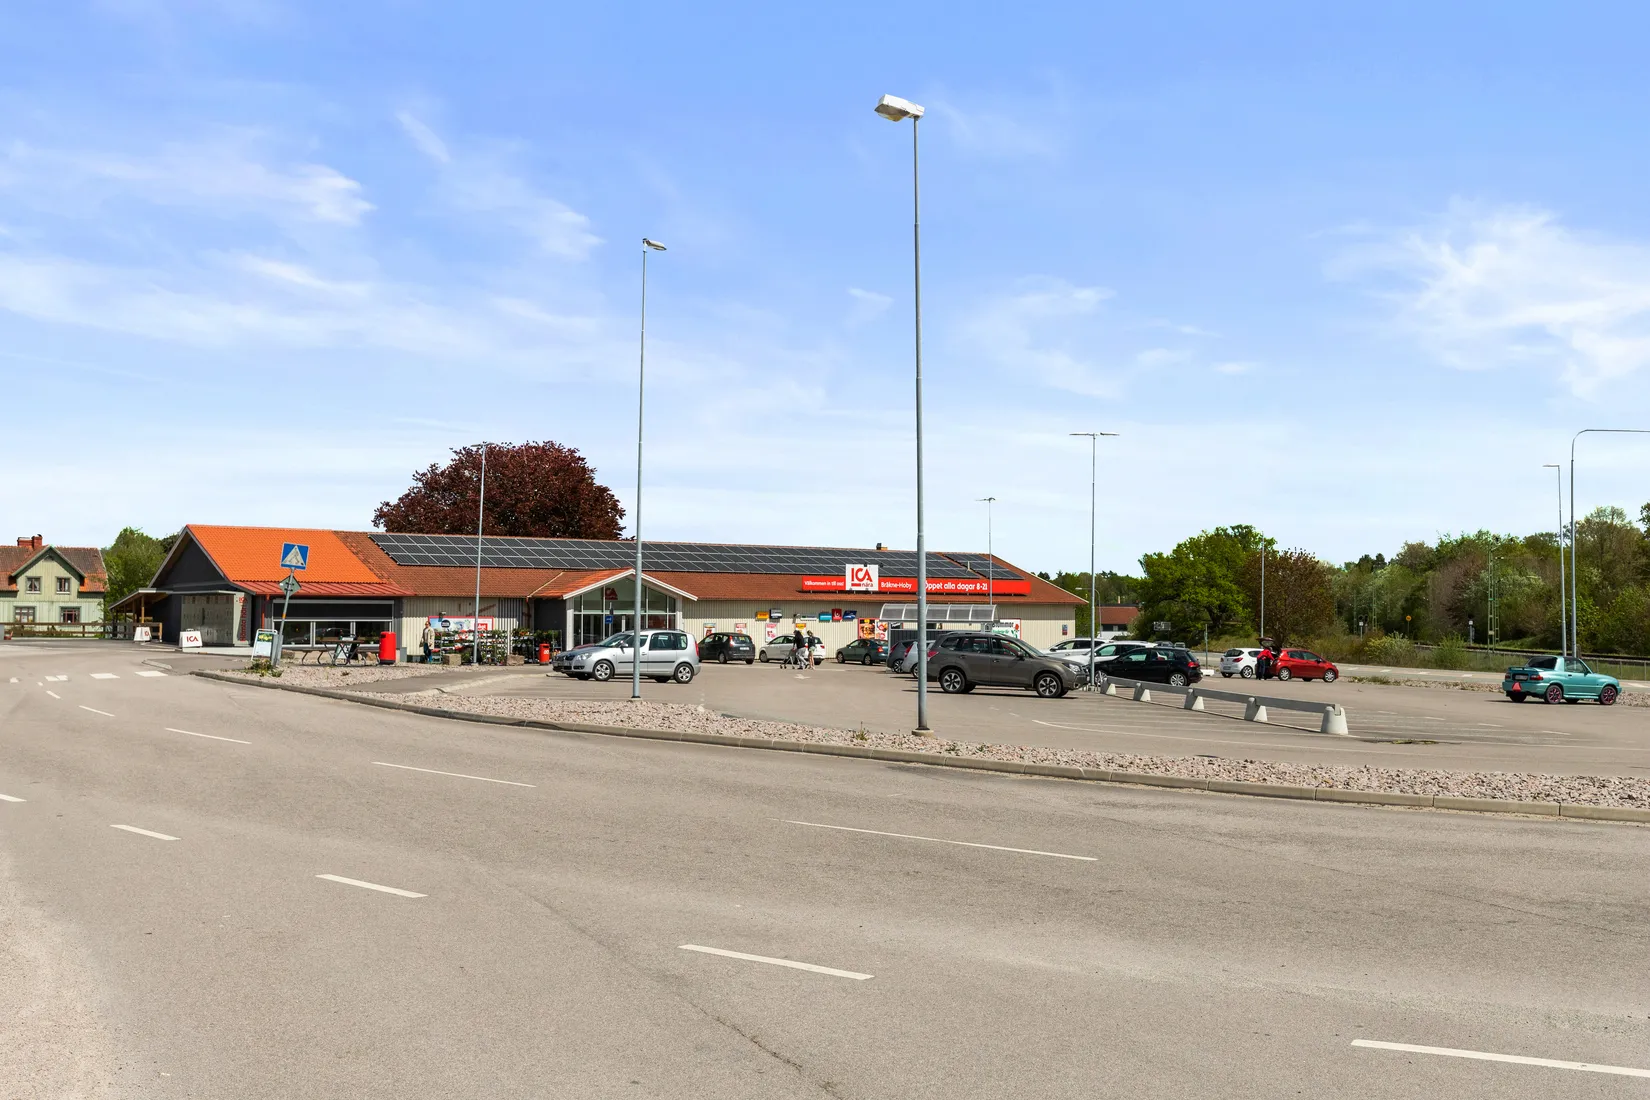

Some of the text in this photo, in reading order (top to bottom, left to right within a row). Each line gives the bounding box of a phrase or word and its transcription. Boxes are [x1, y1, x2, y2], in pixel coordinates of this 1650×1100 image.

[851, 567, 873, 582] ICA
[881, 582, 912, 590] Bråkne-Hoby
[944, 582, 955, 590] alla
[957, 582, 976, 591] dagar
